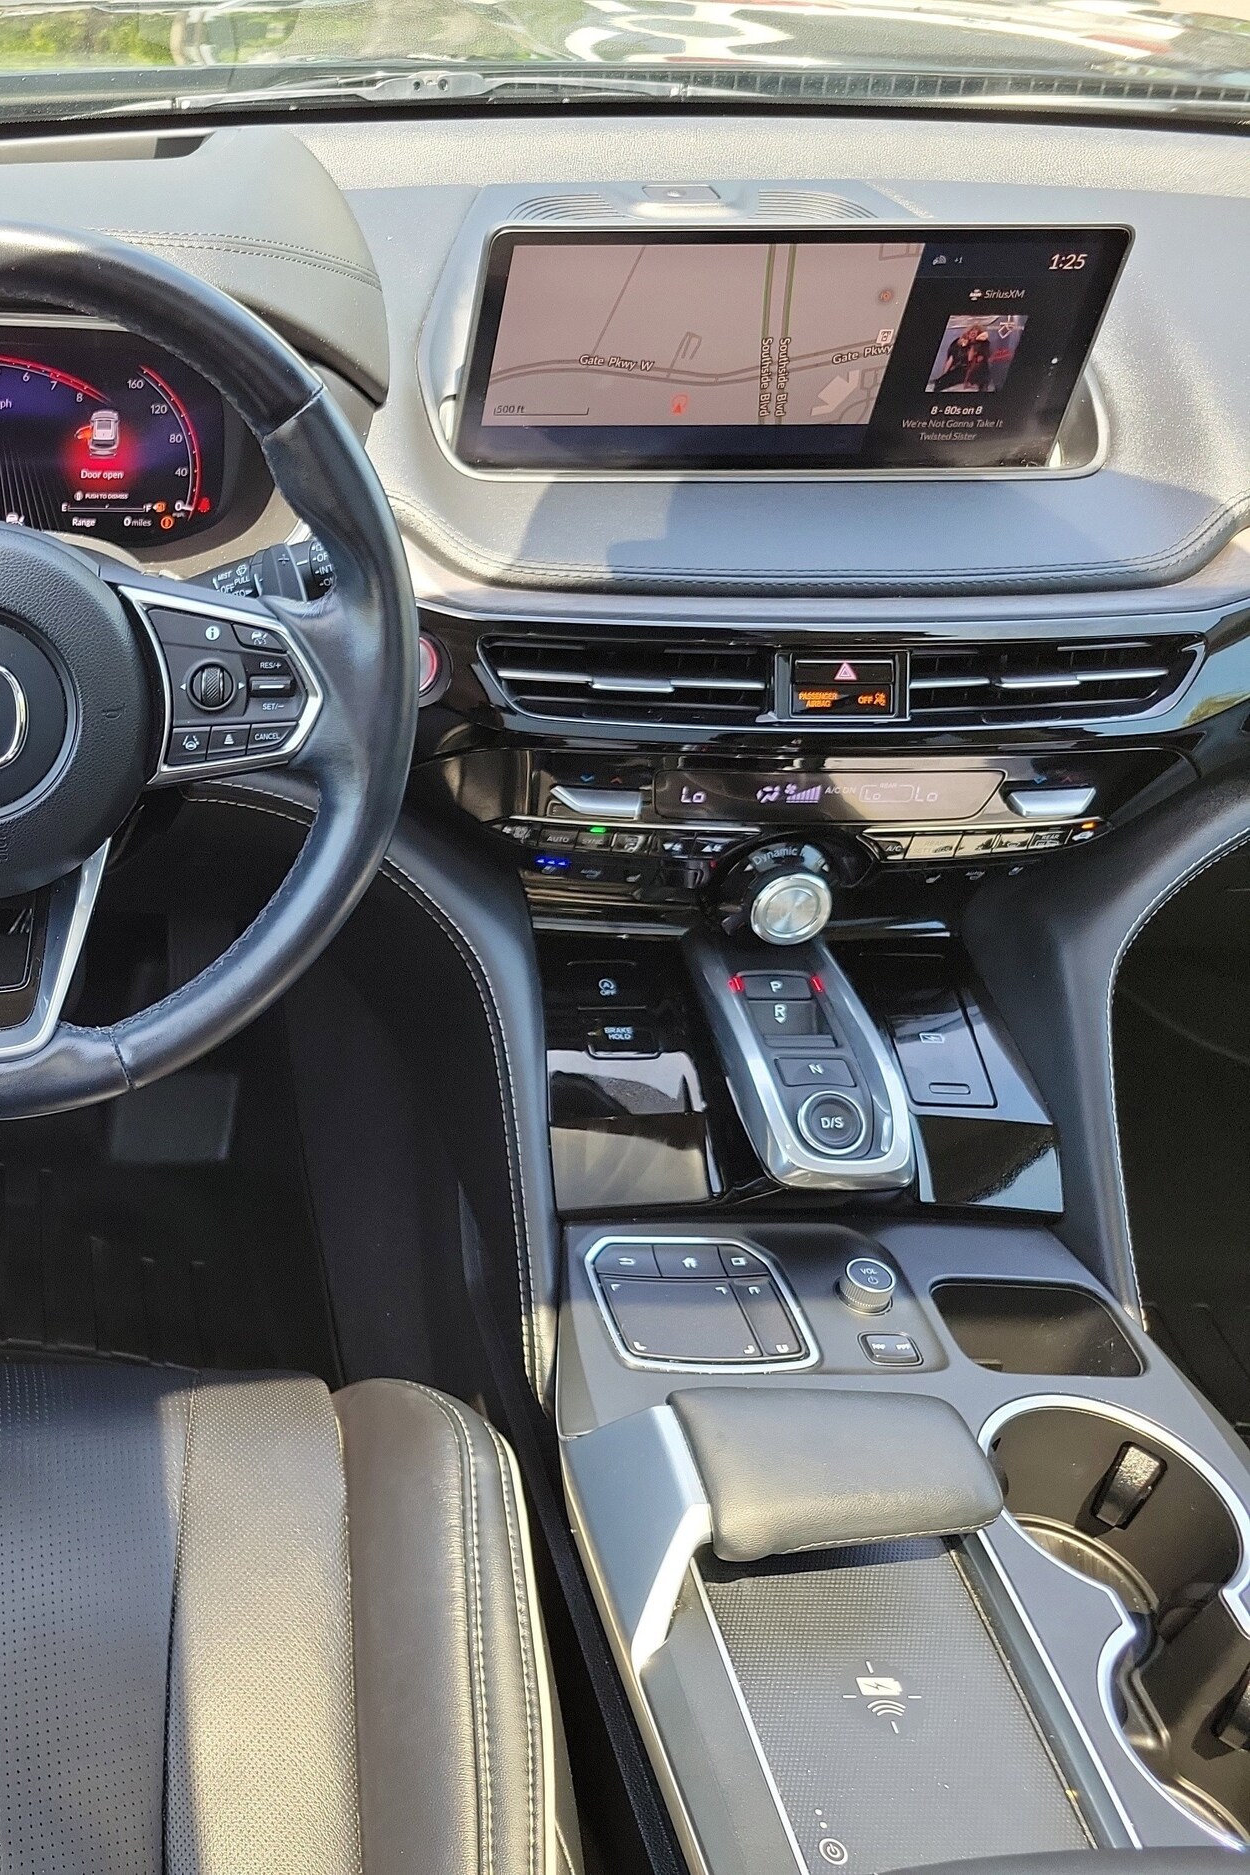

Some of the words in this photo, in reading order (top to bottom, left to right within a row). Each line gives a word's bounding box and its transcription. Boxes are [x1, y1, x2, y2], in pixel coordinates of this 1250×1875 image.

[1048, 254, 1087, 270] 1:25
[984, 289, 1025, 299] SiriusXM
[833, 353, 859, 364] Gate
[864, 345, 893, 357] Pkwy
[579, 354, 604, 366] Gate
[608, 357, 636, 370] Pkwy
[639, 359, 654, 371] W
[760, 338, 773, 390] Southside
[776, 338, 791, 390] Southside
[23, 372, 30, 382] 6
[50, 381, 58, 391] 7
[127, 380, 144, 389] 160
[76, 393, 83, 403] 8
[150, 405, 168, 414] 120
[496, 405, 513, 415] 500
[514, 405, 525, 415] ft
[759, 393, 771, 417] Blvd
[774, 393, 787, 417] Blvd
[930, 406, 938, 415] 8
[944, 406, 961, 415] 80s
[962, 407, 974, 415] on
[975, 406, 983, 415] 8
[902, 419, 927, 428] We're
[928, 419, 945, 428] Not
[946, 420, 974, 428] Gonna
[976, 420, 995, 428] Take
[996, 419, 1003, 428] It
[169, 434, 183, 443] 80
[919, 432, 951, 440] Twisted
[952, 432, 977, 440] Sister
[80, 469, 102, 479] Door
[102, 470, 124, 480] open
[175, 467, 188, 477] 40
[61, 504, 67, 512] E
[146, 504, 152, 512] F
[174, 500, 182, 511] 0
[72, 517, 96, 527] Range
[123, 516, 132, 527] 0
[132, 518, 151, 527] miles
[217, 571, 233, 580] MIST
[234, 576, 250, 586] PULL
[220, 583, 235, 592] OFF
[260, 661, 282, 669] RES/+
[798, 692, 838, 700] PASSENGER
[858, 695, 873, 705] OFF
[806, 700, 832, 708] AIRBAG
[254, 732, 281, 741] CANCEL
[680, 786, 707, 803] Lo
[825, 786, 841, 795] A/C
[864, 789, 881, 801] Lo
[914, 786, 938, 802] Lo
[546, 835, 570, 843] AUTO
[751, 847, 797, 866] Dynamic
[770, 981, 782, 992] P
[774, 1004, 787, 1017] R
[808, 1064, 824, 1074] N
[820, 1116, 844, 1129] D/S
